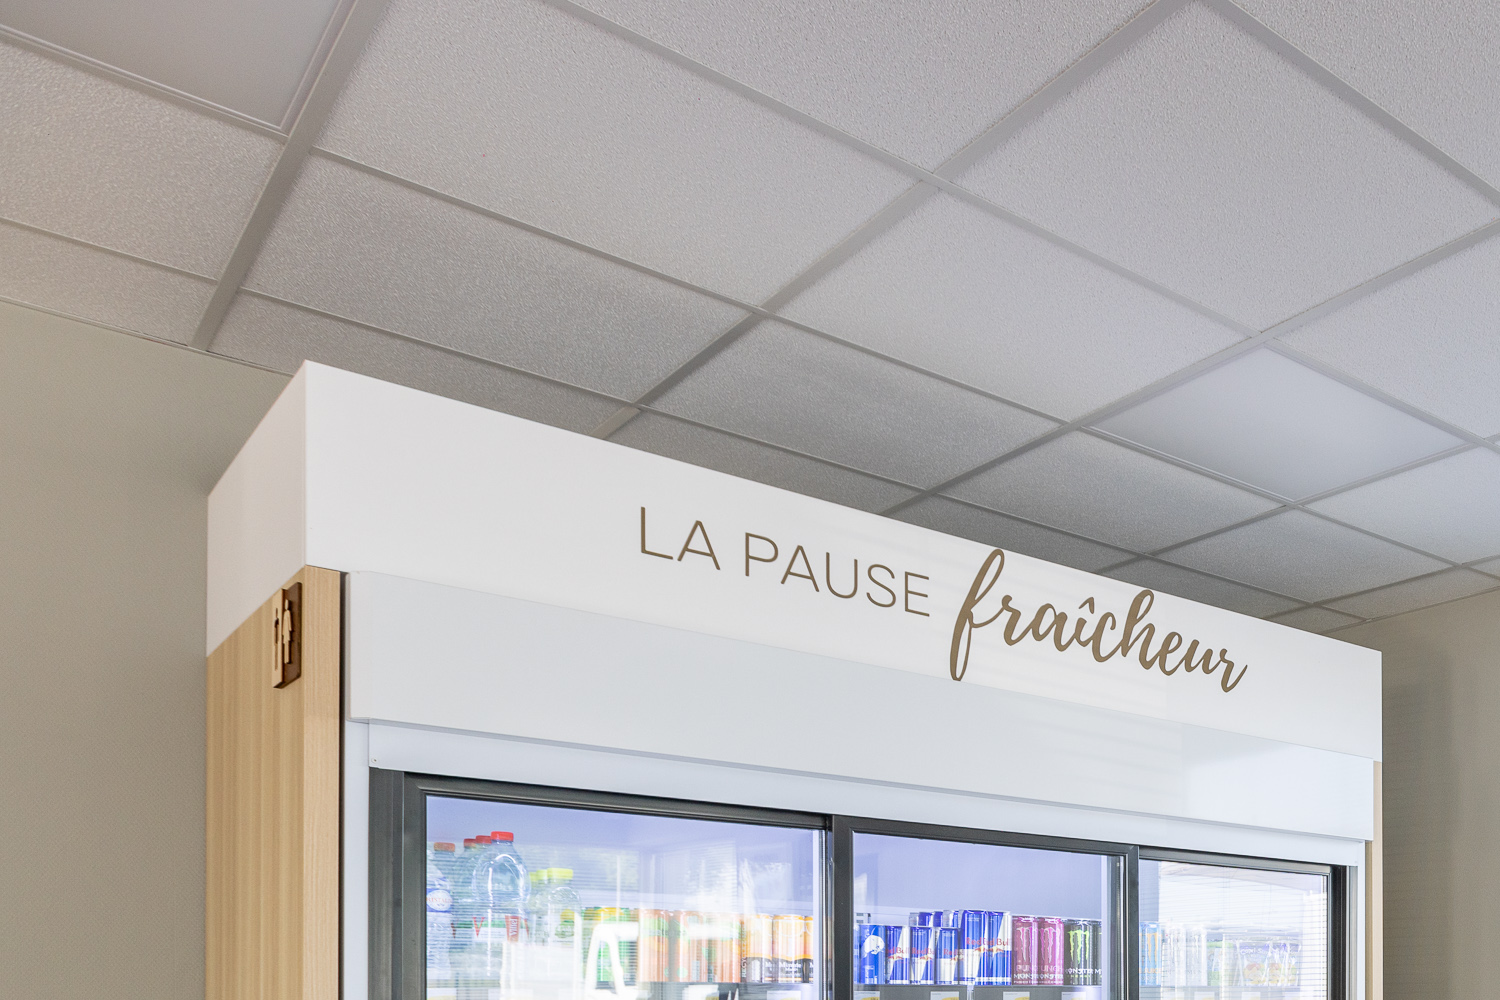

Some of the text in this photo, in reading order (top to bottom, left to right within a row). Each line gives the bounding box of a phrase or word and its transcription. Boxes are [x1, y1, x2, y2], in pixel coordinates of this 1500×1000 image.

[640, 506, 1248, 692] LA PAUSE fraîcheur
